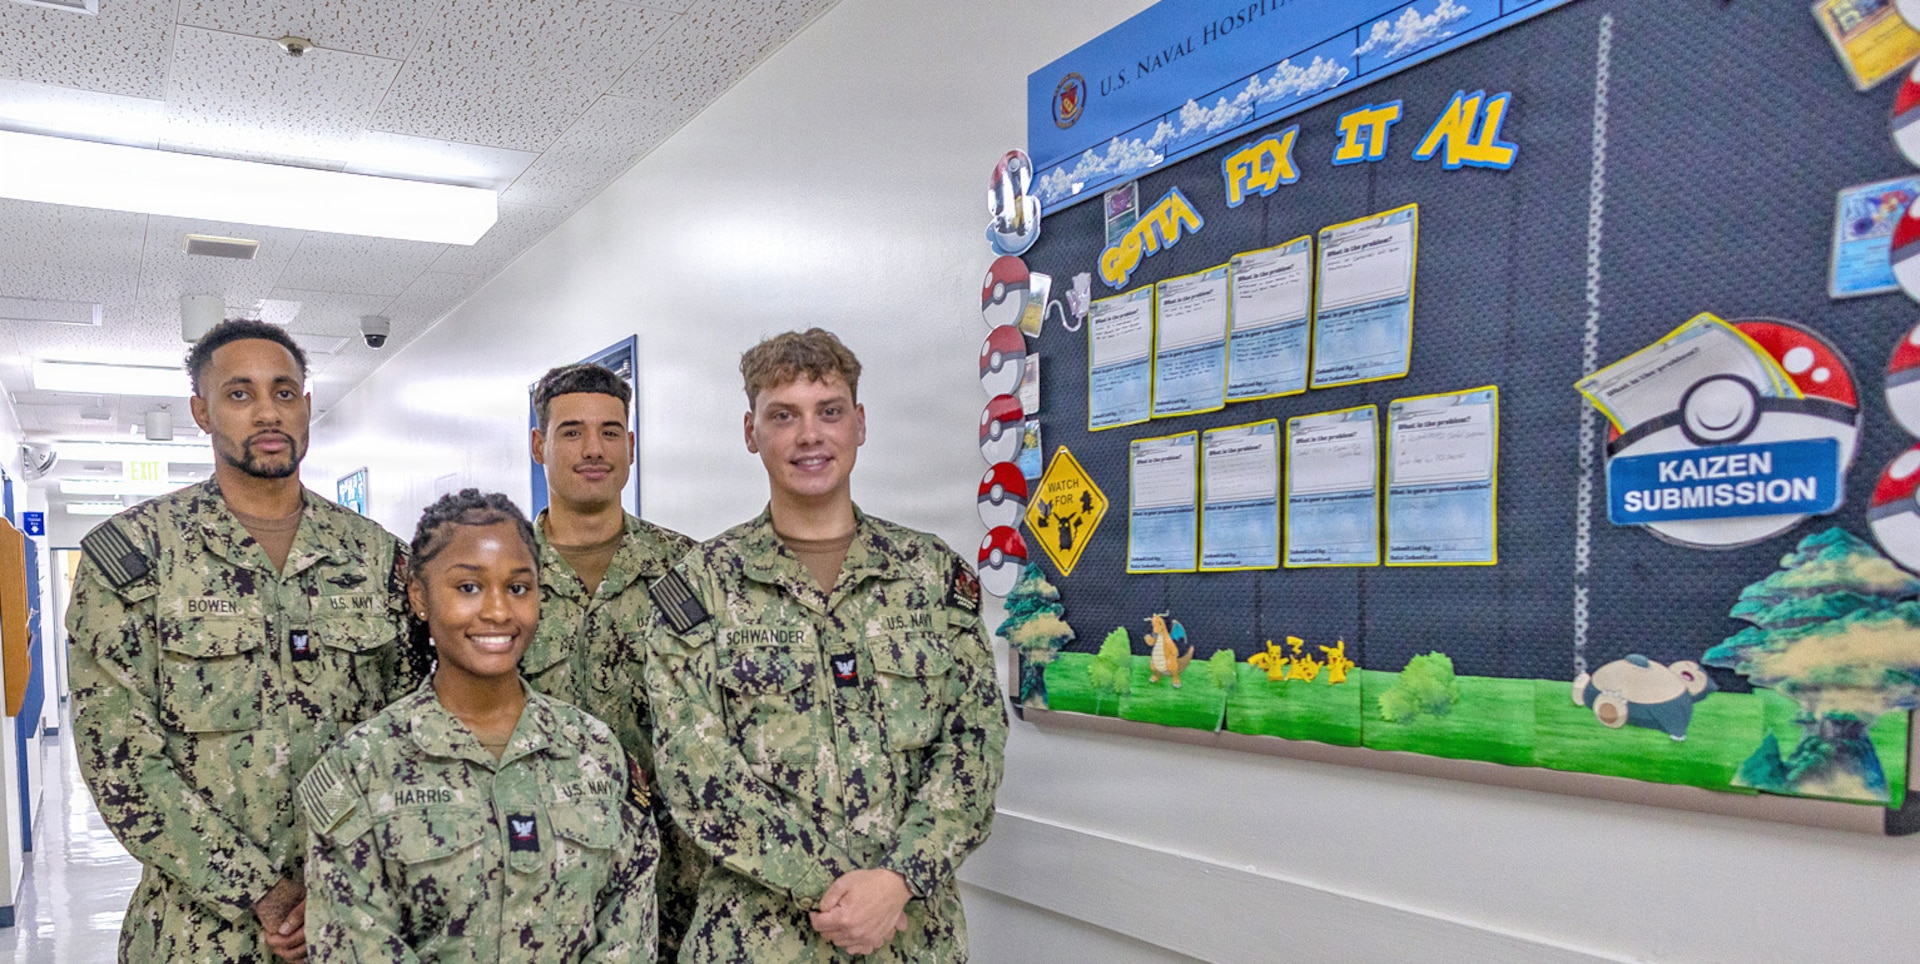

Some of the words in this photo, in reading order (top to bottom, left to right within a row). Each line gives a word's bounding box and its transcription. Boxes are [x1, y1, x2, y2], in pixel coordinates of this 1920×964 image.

[1100, 69, 1130, 97] U.S.
[1137, 36, 1196, 80] NAVAL
[1100, 189, 1202, 286] GOTTA
[1224, 128, 1297, 205] FIX
[1334, 103, 1401, 162] IT
[1414, 94, 1516, 167] ALL
[1327, 249, 1342, 258] What
[1361, 236, 1393, 250] problem?
[1606, 383, 1630, 396] What
[1639, 370, 1655, 380] the
[1657, 347, 1700, 372] problem?
[1398, 422, 1416, 430] What
[1436, 416, 1471, 428] problem?
[130, 461, 158, 480] EXIT
[1658, 451, 1772, 483] KAIZEN
[1047, 478, 1079, 493] WATCH
[1624, 476, 1817, 512] SUBMISSION
[1055, 494, 1073, 506] FOR
[188, 600, 237, 613] BOWEN
[330, 597, 349, 609] U.S.
[352, 596, 374, 609] NAVY
[886, 615, 907, 630] U.S.
[910, 612, 932, 627] NAVY
[726, 629, 805, 646] SCHWANDER
[395, 789, 450, 806] HARRIS
[563, 784, 584, 798] U.S.
[589, 780, 613, 796] NAVY
